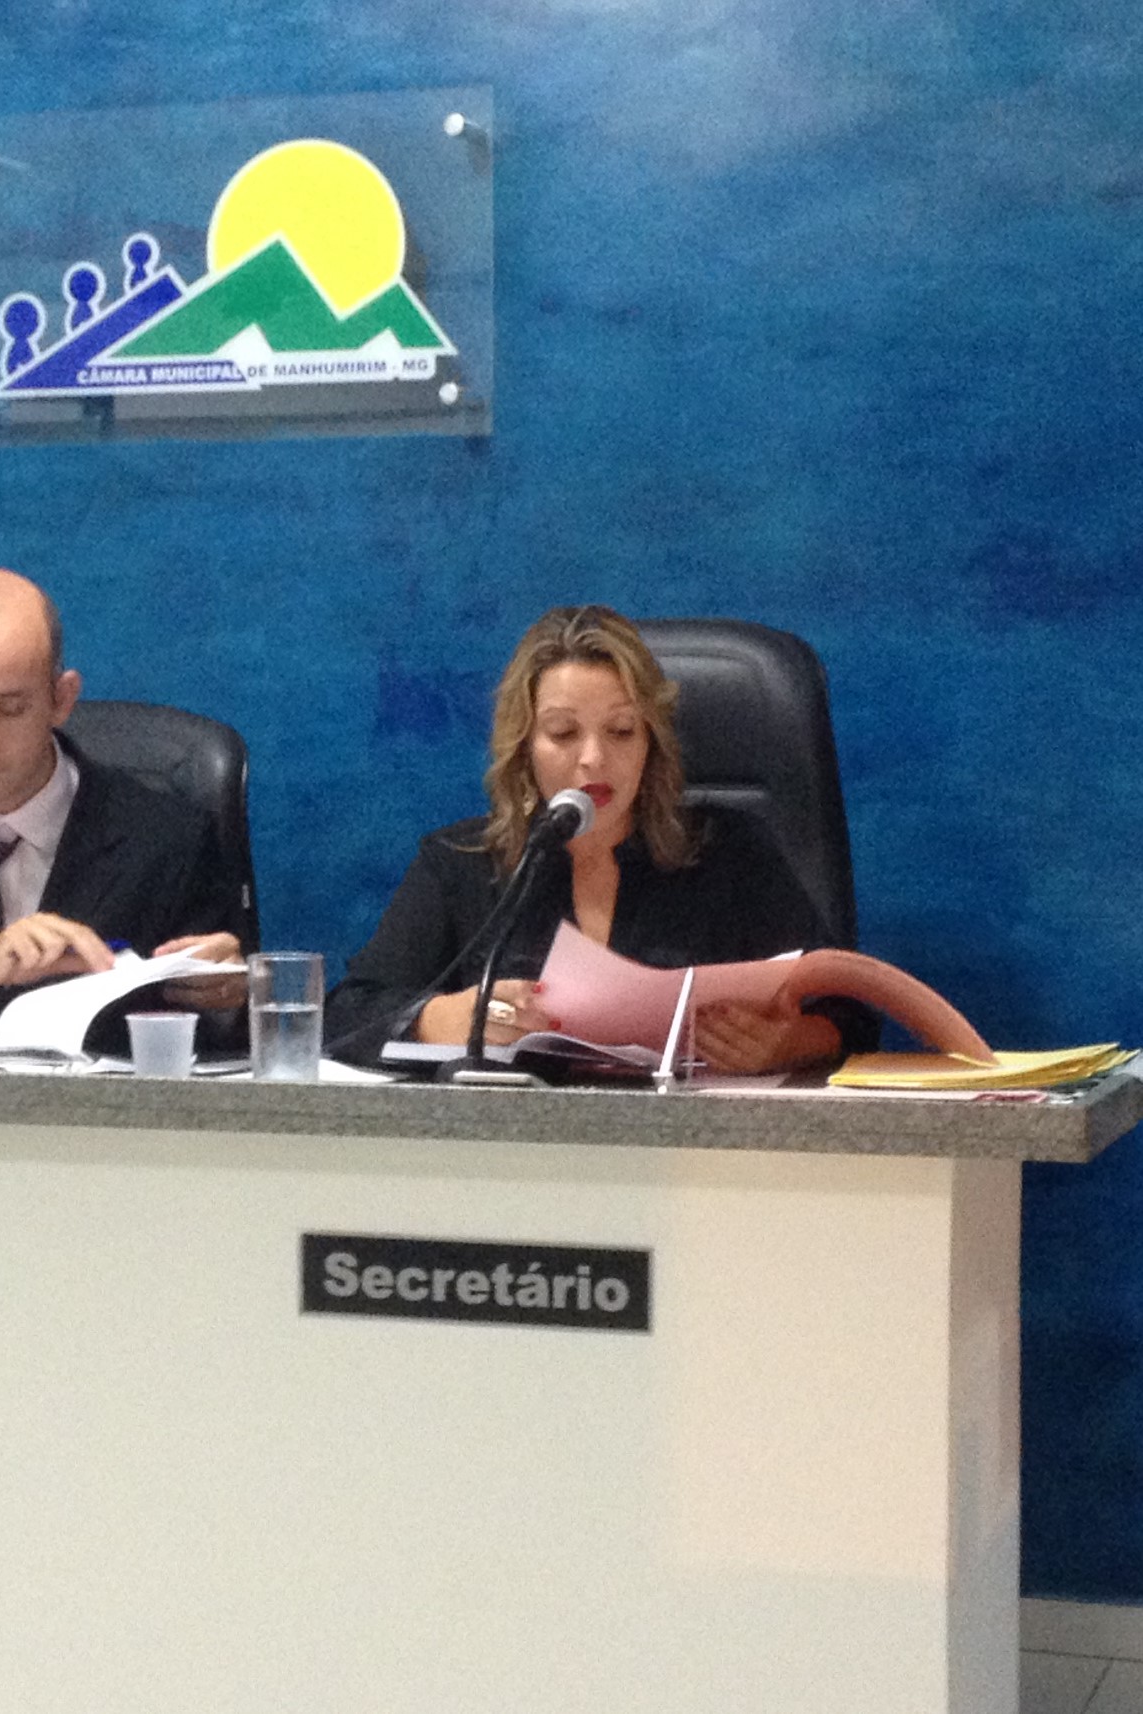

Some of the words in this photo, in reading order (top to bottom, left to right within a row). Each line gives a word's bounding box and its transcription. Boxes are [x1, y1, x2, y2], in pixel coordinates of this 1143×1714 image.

[76, 365, 148, 384] CÂMARA
[151, 364, 243, 382] MUNICIPAL
[247, 365, 268, 378] DE
[274, 360, 388, 376] MANHUMIRIM
[402, 359, 429, 371] MG
[322, 1251, 631, 1313] Secretário
